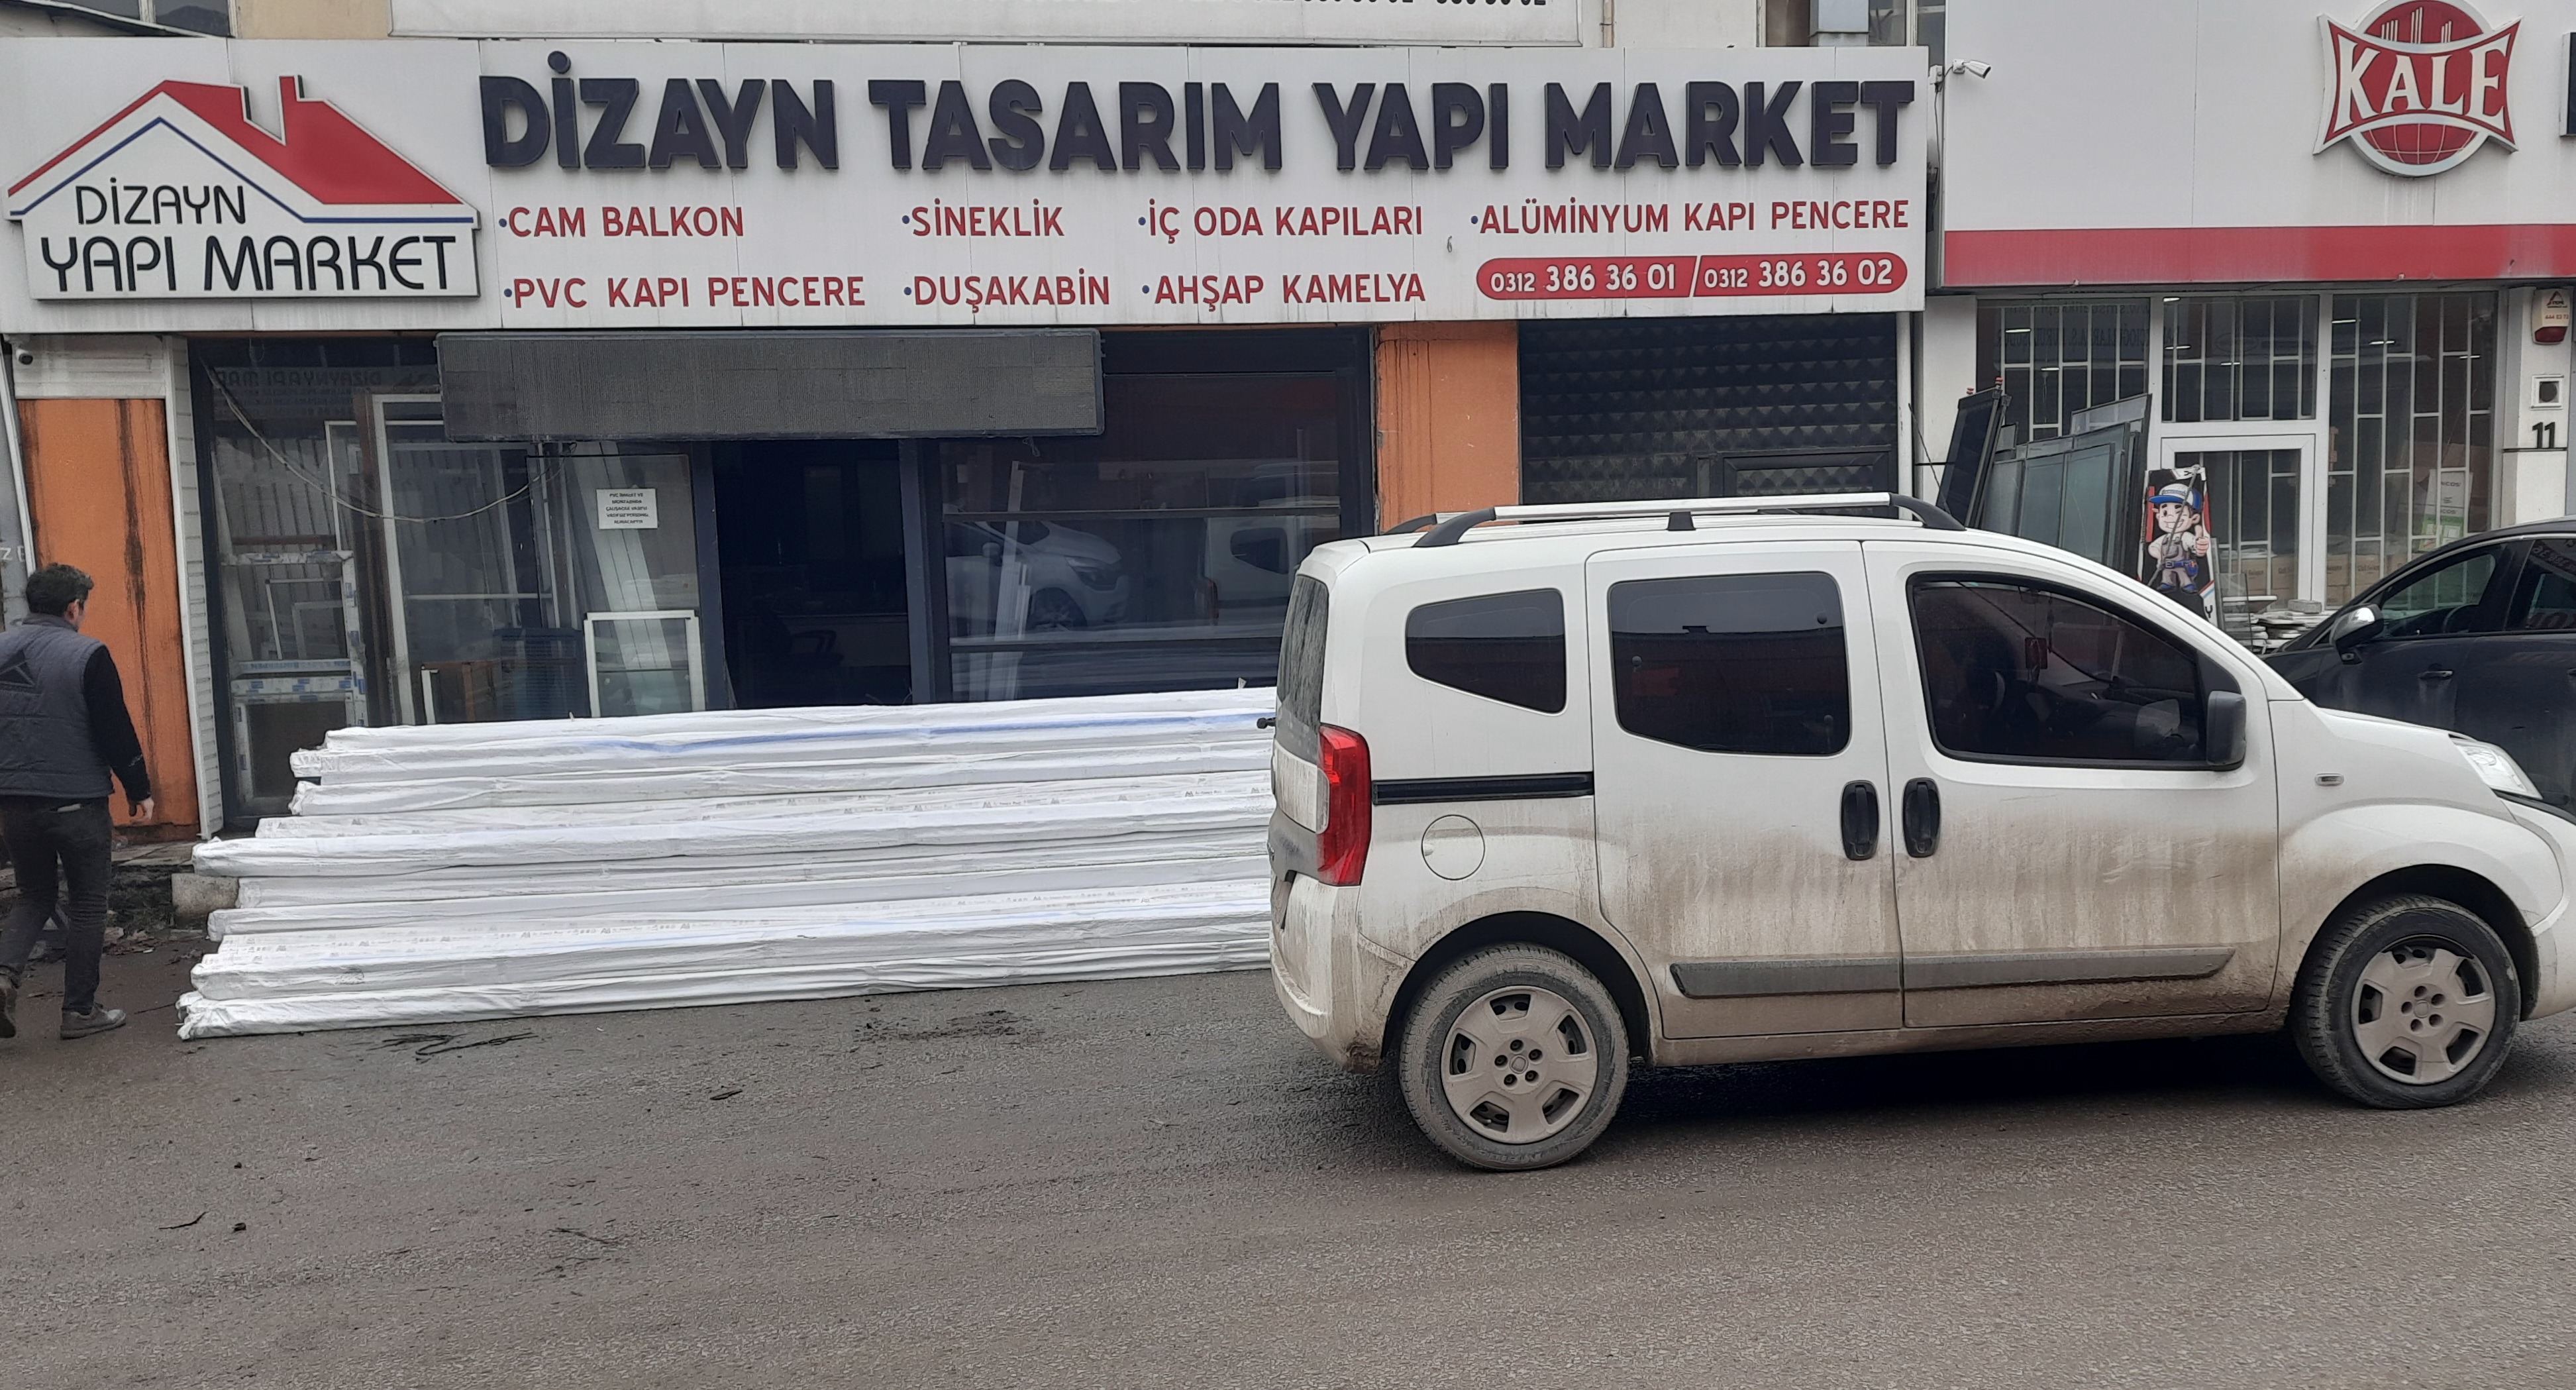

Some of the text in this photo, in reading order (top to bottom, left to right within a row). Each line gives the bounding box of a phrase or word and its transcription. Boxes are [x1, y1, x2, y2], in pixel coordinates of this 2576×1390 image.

[2333, 32, 2511, 133] KALE
[479, 51, 1915, 170] DİZAYN TASARIM YAPI MARKET
[76, 178, 246, 225] DİZAYN
[911, 198, 1065, 237] SİNEKLİK
[1149, 198, 1423, 244] İÇ ODA KAPILARI
[1480, 197, 1909, 234] ALÜMİNYUM KAPI PENCERE
[509, 206, 744, 237] CAM BALKON
[41, 235, 456, 292] YAPI MARKET
[1490, 263, 1675, 292] 0312 386 36 01
[1704, 258, 1892, 289] 0312 386 36 02
[513, 276, 866, 308] PVC KAPI PENCERE
[913, 268, 1110, 313] DUŞAKABİN
[1155, 273, 1425, 312] AHŞAP KAMELYA
[2532, 421, 2555, 449] 11
